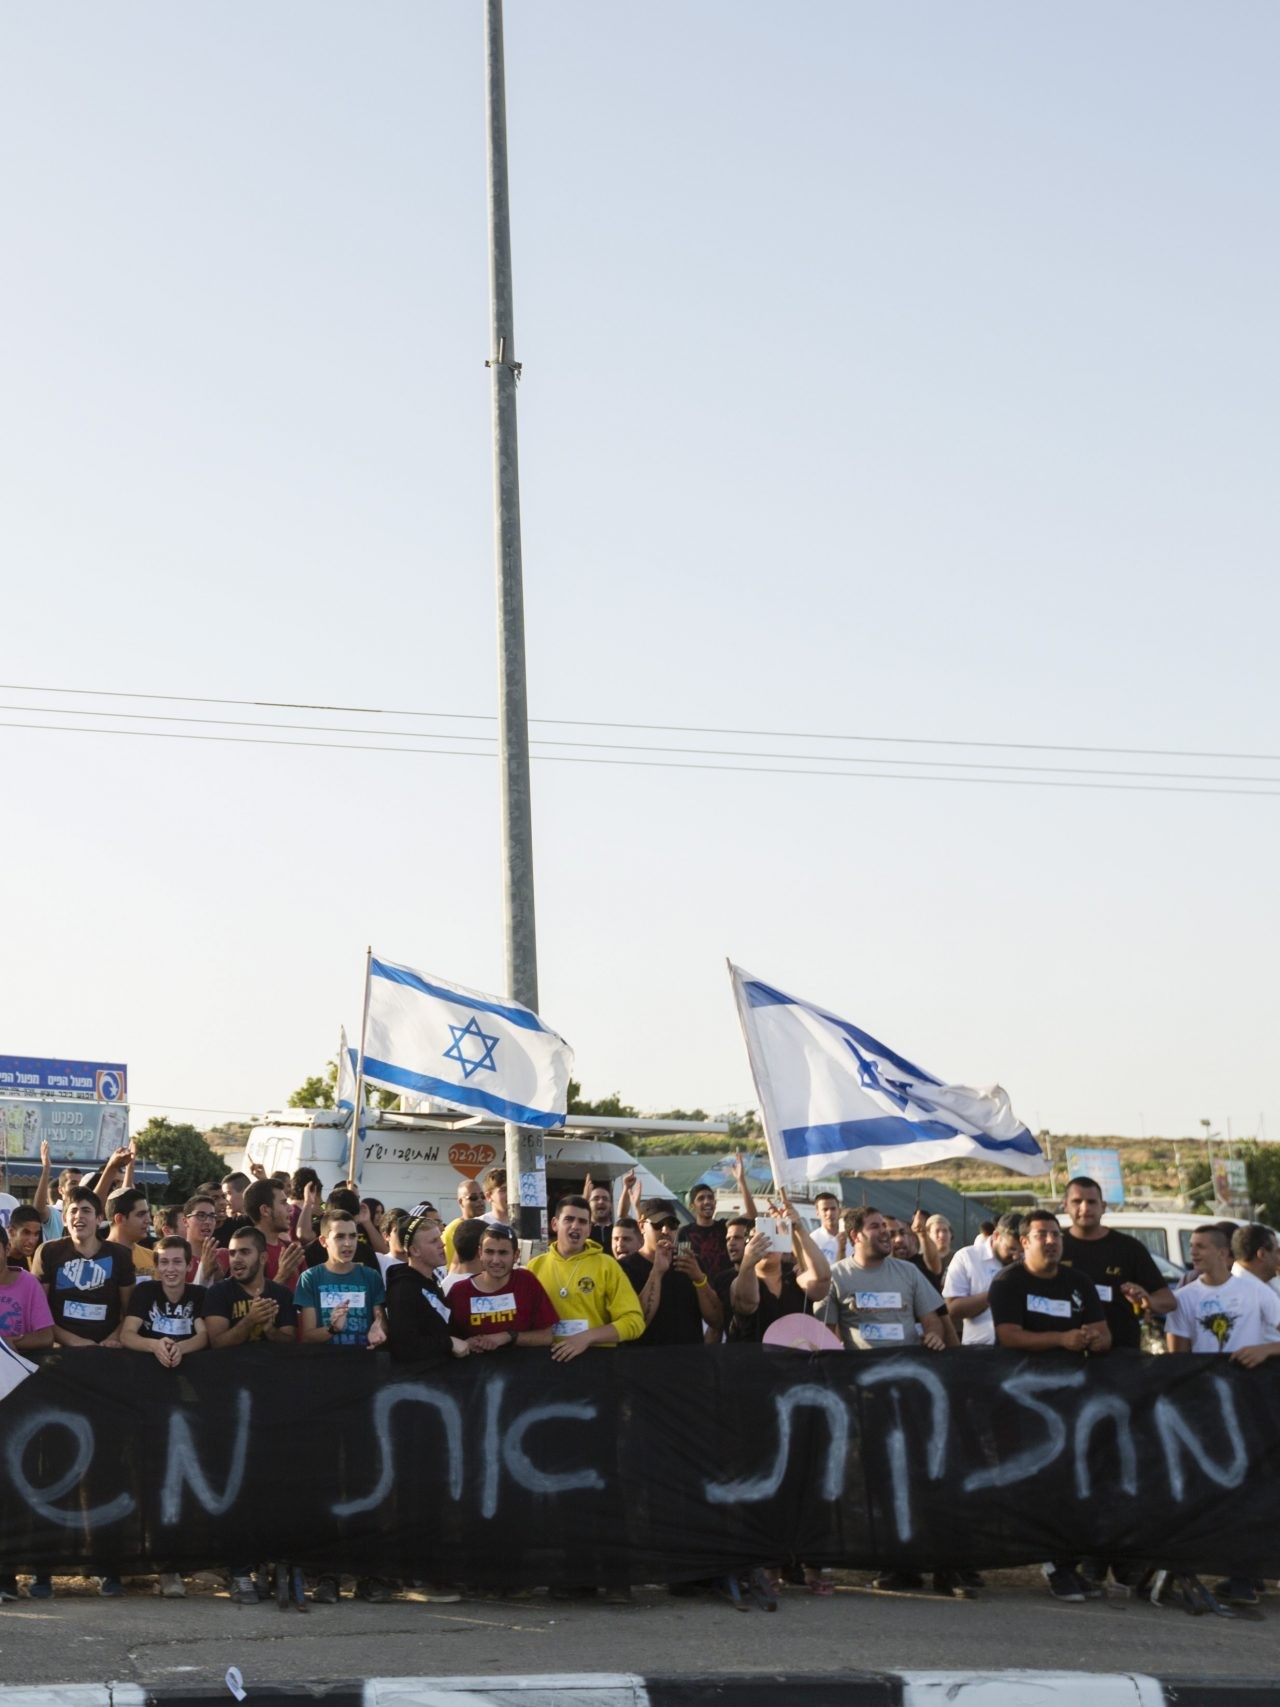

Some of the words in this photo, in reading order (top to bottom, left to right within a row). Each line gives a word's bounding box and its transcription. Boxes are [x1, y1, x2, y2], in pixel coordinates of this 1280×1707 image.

[16, 1071, 40, 1085] מפעל
[48, 1075, 69, 1086] הפיס
[70, 1075, 93, 1088] מפעל
[51, 1110, 83, 1126] מפגש
[40, 1127, 67, 1143] עציון
[71, 1128, 95, 1143] כיכר
[448, 1146, 495, 1163] באהבה
[330, 1373, 605, 1520] את
